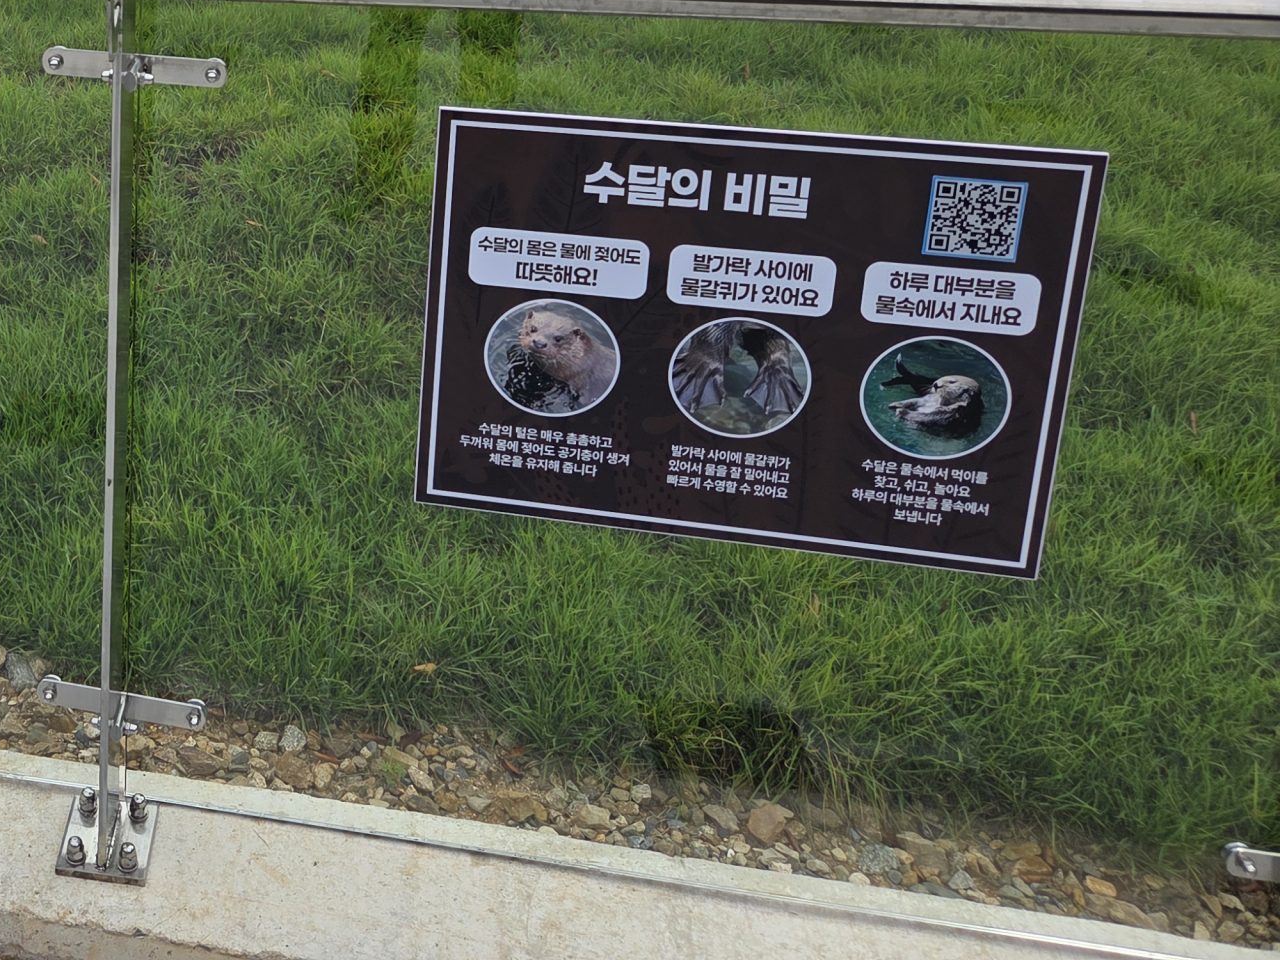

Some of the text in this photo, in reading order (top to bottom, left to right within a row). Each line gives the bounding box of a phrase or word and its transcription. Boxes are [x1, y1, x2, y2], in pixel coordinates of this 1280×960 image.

[583, 161, 811, 219] 수달의 비밀
[478, 236, 641, 265] 수달의 몸은 물에 젖어도
[515, 261, 598, 286] 따뜻해요!
[693, 253, 813, 282] 발가락 사이에
[680, 278, 819, 308] 물갈퀴가 있어요
[889, 270, 1016, 300] 하루 대부분을
[875, 295, 1022, 326] 물속에서 지내요
[478, 422, 512, 438] 수달의
[515, 426, 538, 441] 털은
[540, 429, 564, 443] 매우
[459, 434, 493, 450] 두꺼워
[521, 441, 555, 457] 젖어도
[557, 446, 604, 463] 공기층이
[606, 451, 630, 467] 생겨
[671, 444, 791, 469] 발가락 사이에 물갈퀴가
[489, 453, 597, 478] 체온을 유지해 줍니다
[668, 460, 790, 483] 있어서 물을 잘 밀어내고
[861, 459, 988, 485] 수달은 물속에서 먹이를
[666, 474, 788, 499] 빠르게 수영할 수 있어요
[874, 475, 970, 498] 찾고, 쉬고, 놀아요
[852, 488, 989, 516] 하루의 대부분을 물속에서
[893, 508, 942, 526] 보냅니다
